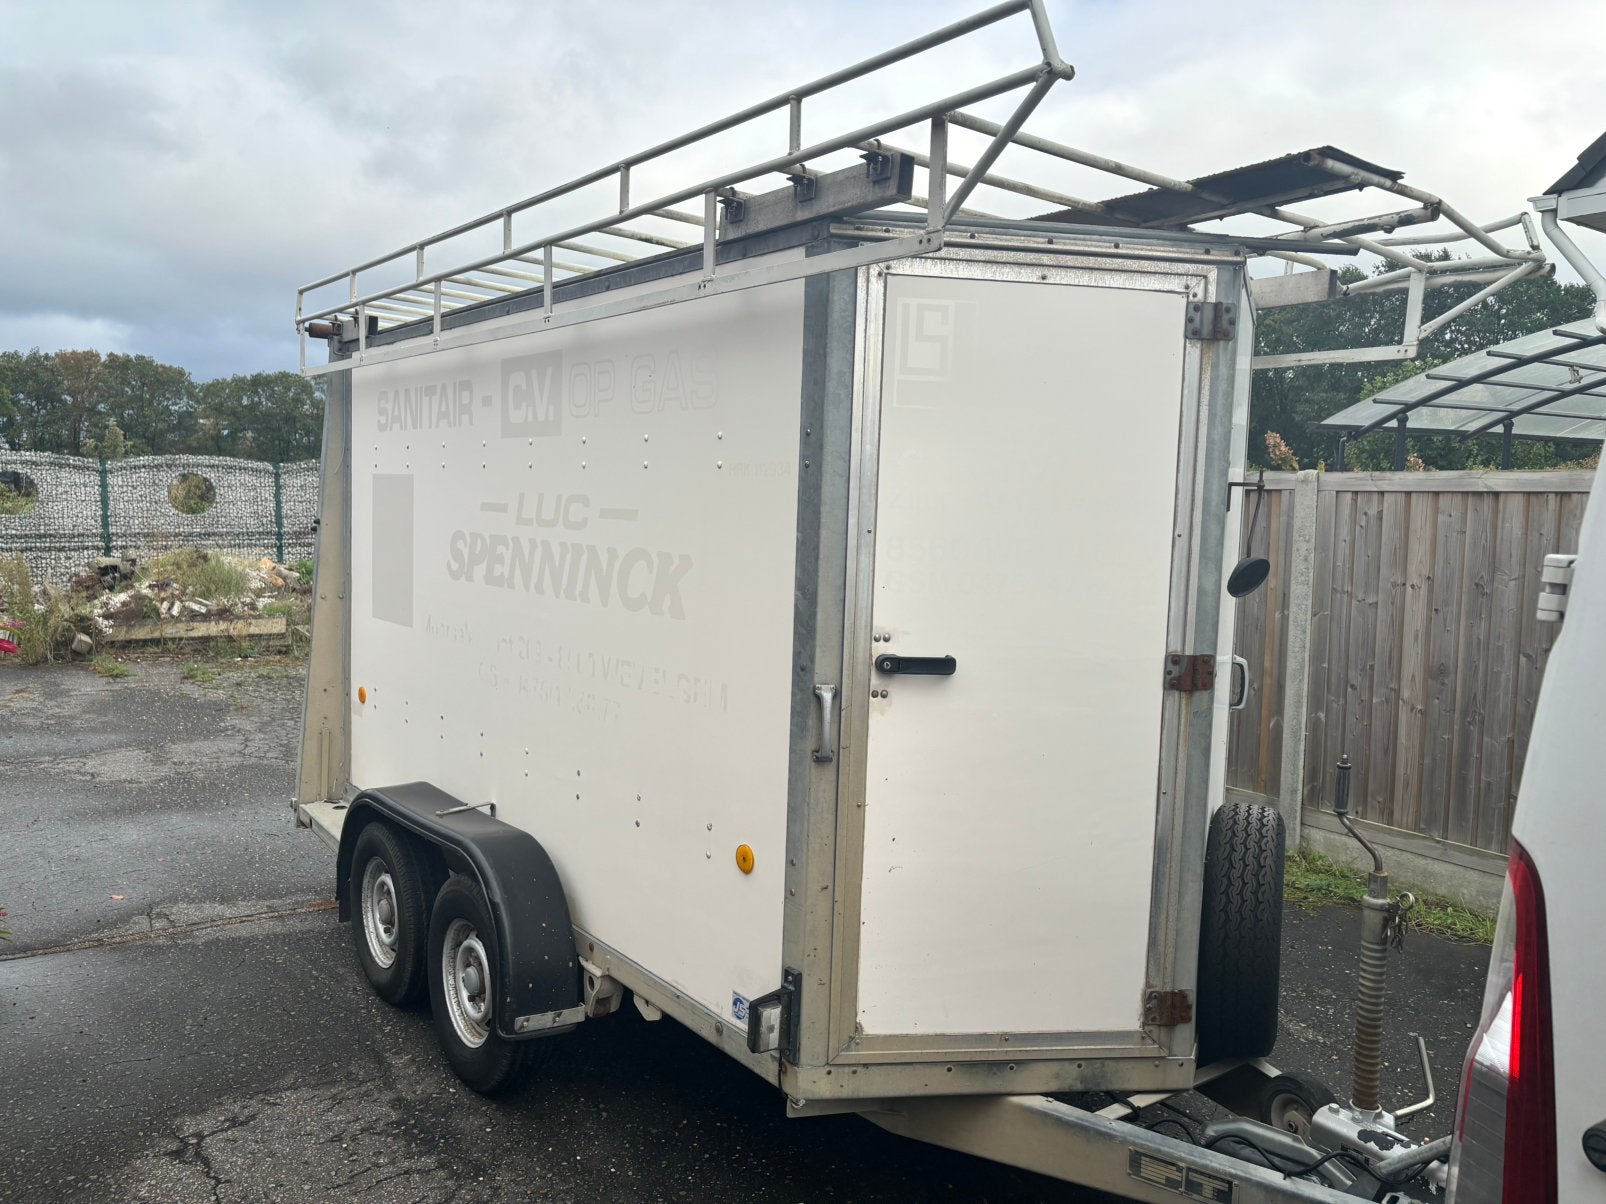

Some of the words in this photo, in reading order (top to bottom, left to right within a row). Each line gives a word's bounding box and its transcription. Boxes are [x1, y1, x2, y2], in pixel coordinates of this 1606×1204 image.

[376, 378, 474, 433] SANITAIR
[568, 358, 616, 420] OP
[629, 345, 720, 417] GAS
[515, 491, 591, 531] LUC
[446, 529, 696, 621] SPENNINCK
